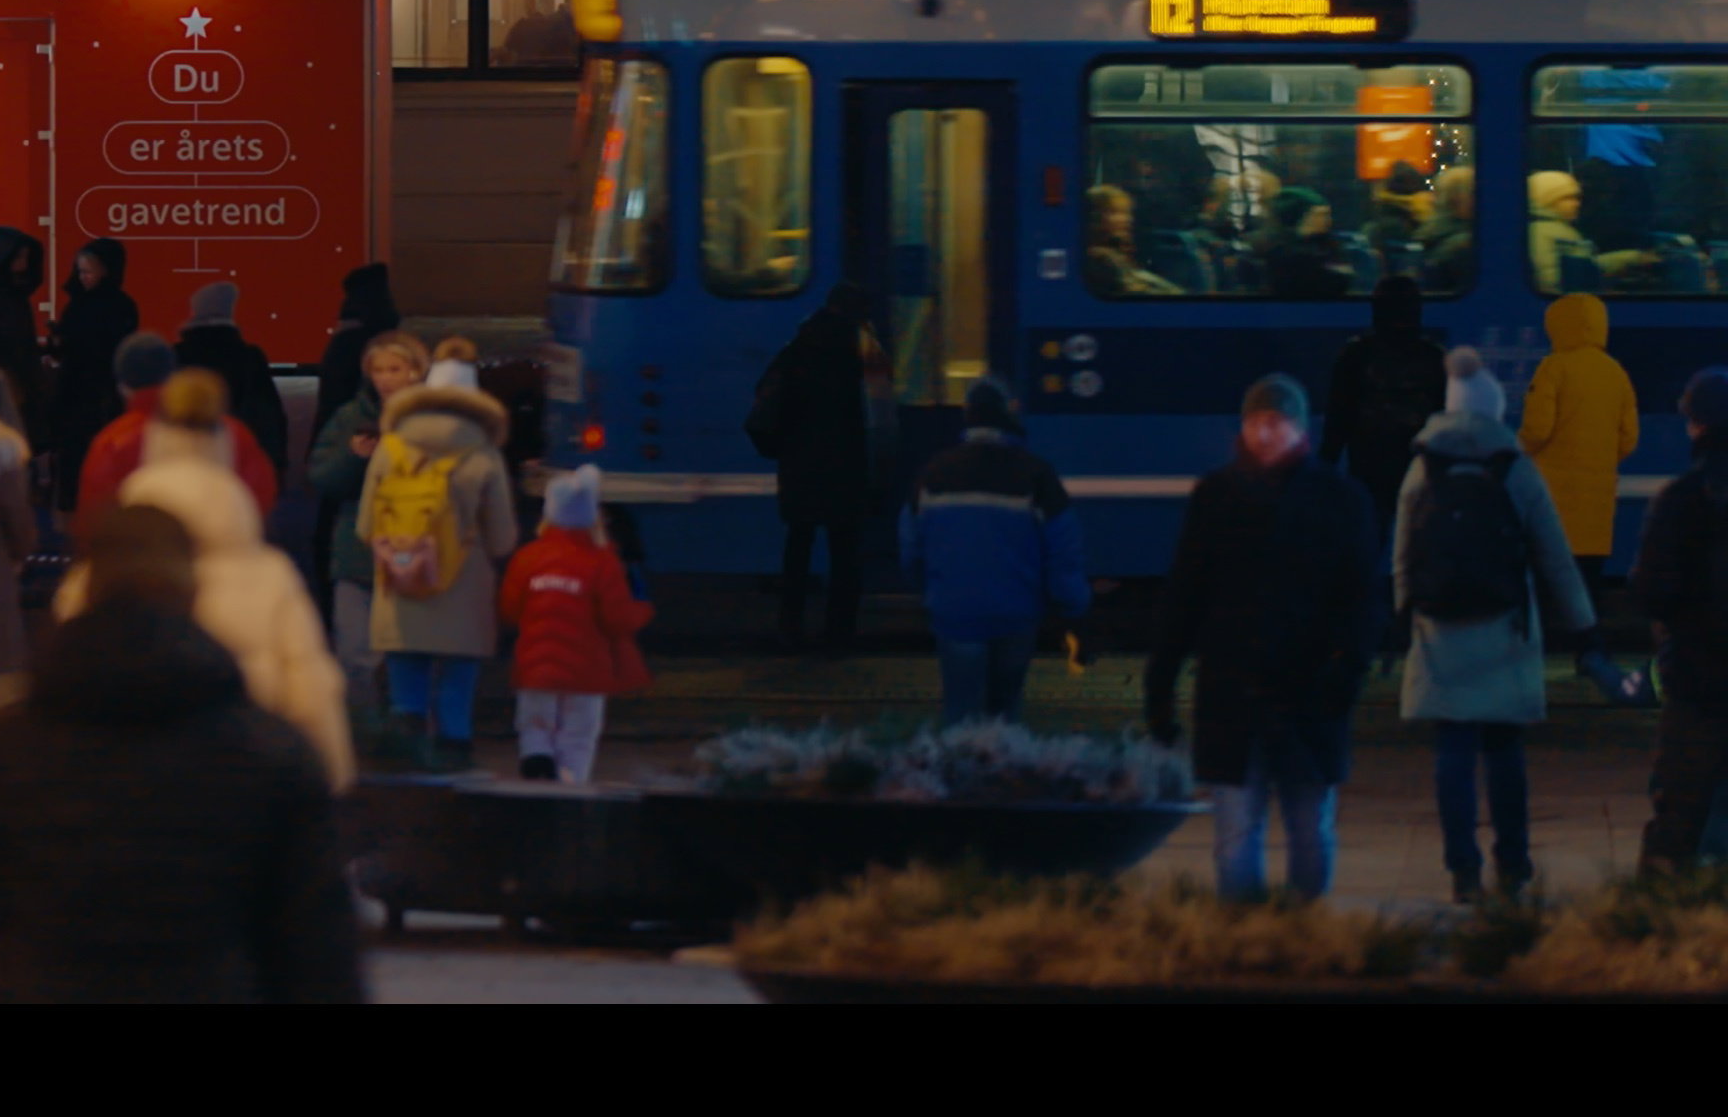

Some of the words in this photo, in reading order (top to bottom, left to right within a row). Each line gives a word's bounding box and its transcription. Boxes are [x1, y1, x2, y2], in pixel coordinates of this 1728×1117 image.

[174, 63, 220, 93] Du
[129, 137, 166, 161] er
[175, 129, 265, 161] årets
[107, 197, 286, 232] gavetrend
